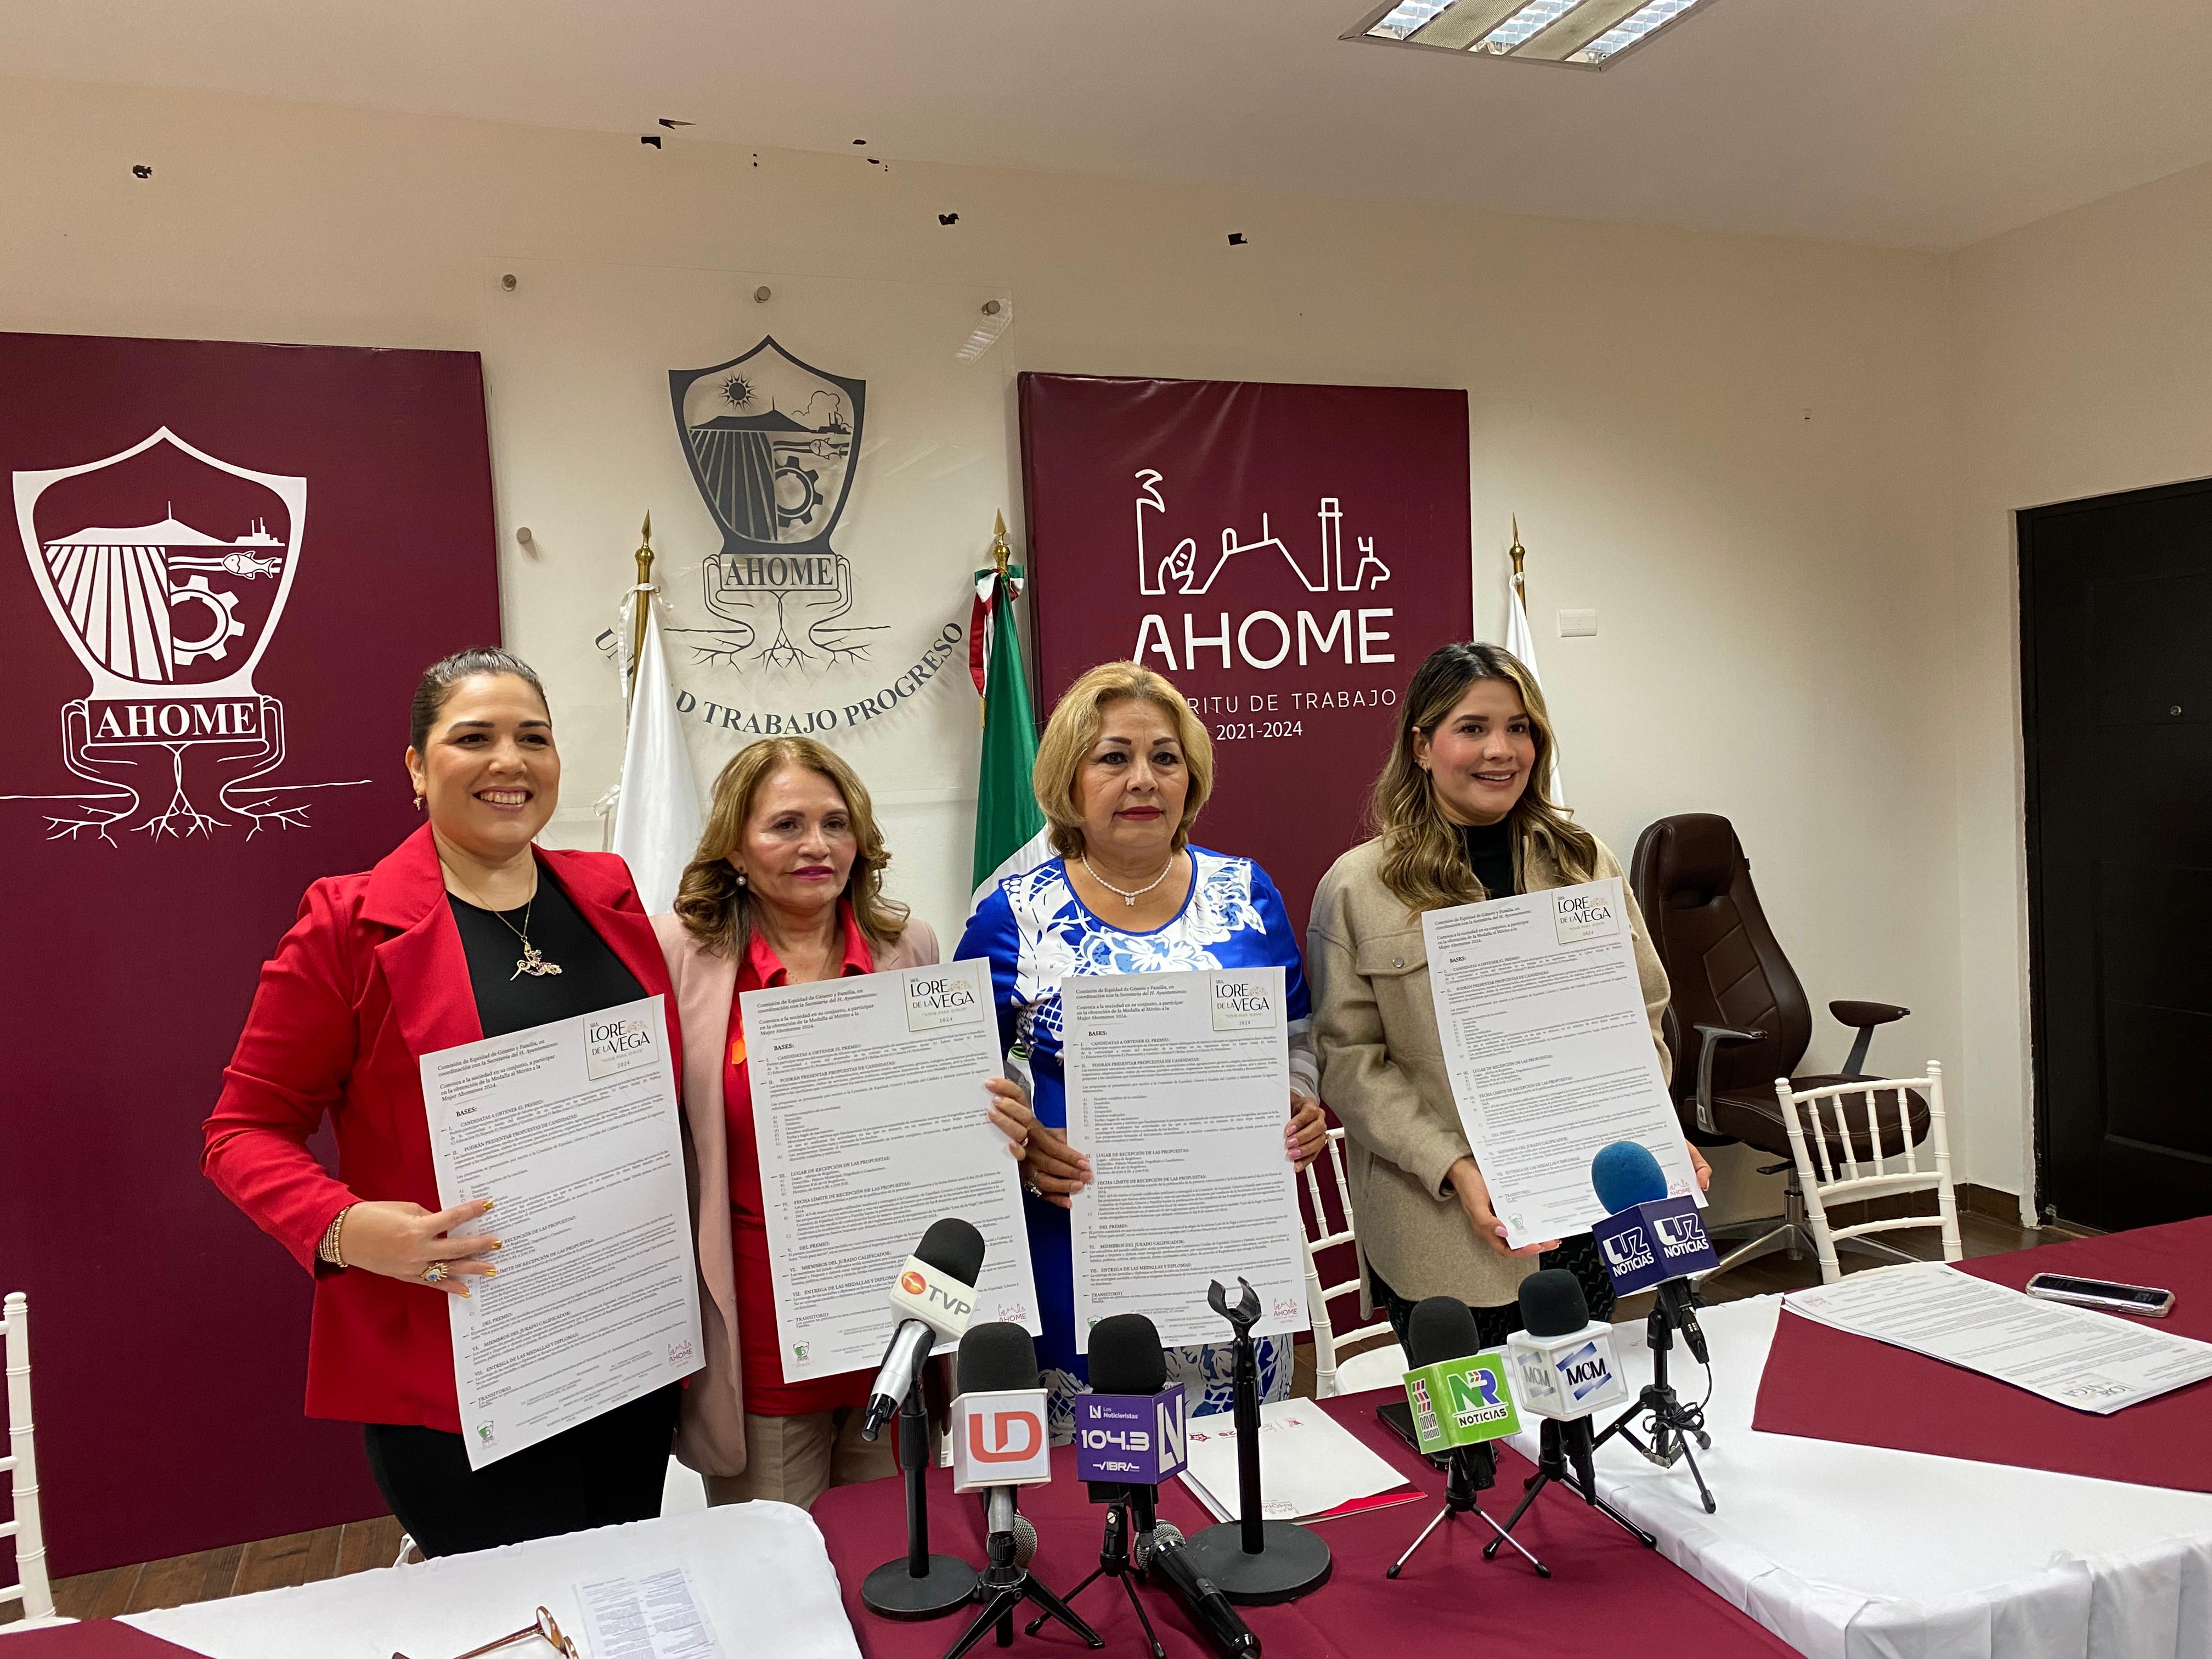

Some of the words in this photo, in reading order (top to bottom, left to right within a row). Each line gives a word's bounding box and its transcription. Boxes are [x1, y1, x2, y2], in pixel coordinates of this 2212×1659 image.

[724, 556, 834, 586] AHOME
[1132, 608, 1395, 671] AHOME
[703, 701, 838, 735] TRABAJO
[843, 622, 963, 727] PROGRESO
[1250, 694, 1279, 712] DE
[1291, 689, 1396, 709] TRABAJO
[94, 702, 257, 739] AHOME
[1216, 721, 1303, 741] 2021-2024
[1558, 896, 1589, 913] LORE
[1574, 906, 1611, 923] VEGA
[910, 978, 950, 997] LORE
[1216, 983, 1249, 998] LORE
[930, 990, 974, 1009] VEGA
[1232, 996, 1269, 1012] VEGA
[590, 1020, 627, 1043] LORE
[591, 1046, 601, 1056] DE
[602, 1044, 611, 1052] LA
[608, 1031, 651, 1053] VEGA
[617, 1060, 630, 1068] 2024
[442, 1093, 457, 1103] Mujer
[458, 1086, 483, 1097] Ahomense
[455, 1106, 477, 1117] BASES:
[1653, 1212, 1706, 1246] LUZ
[1602, 1226, 1650, 1265] LUZ
[1663, 1238, 1709, 1259] NOTICIAS
[1612, 1252, 1655, 1277] NOTICIAS
[928, 1284, 972, 1316] TVP
[999, 1313, 1027, 1322] AHOME
[1273, 1308, 1298, 1317] AHOME
[669, 1348, 693, 1363] AHOME
[1523, 1365, 1550, 1387] MCM
[1566, 1357, 1607, 1386] MCM
[1446, 1368, 1503, 1413] NR
[1420, 1413, 1437, 1430] NOVA
[1459, 1408, 1507, 1426] NOTICIAS
[1081, 1429, 1150, 1451] 104.3
[1423, 1427, 1440, 1440] RADIO
